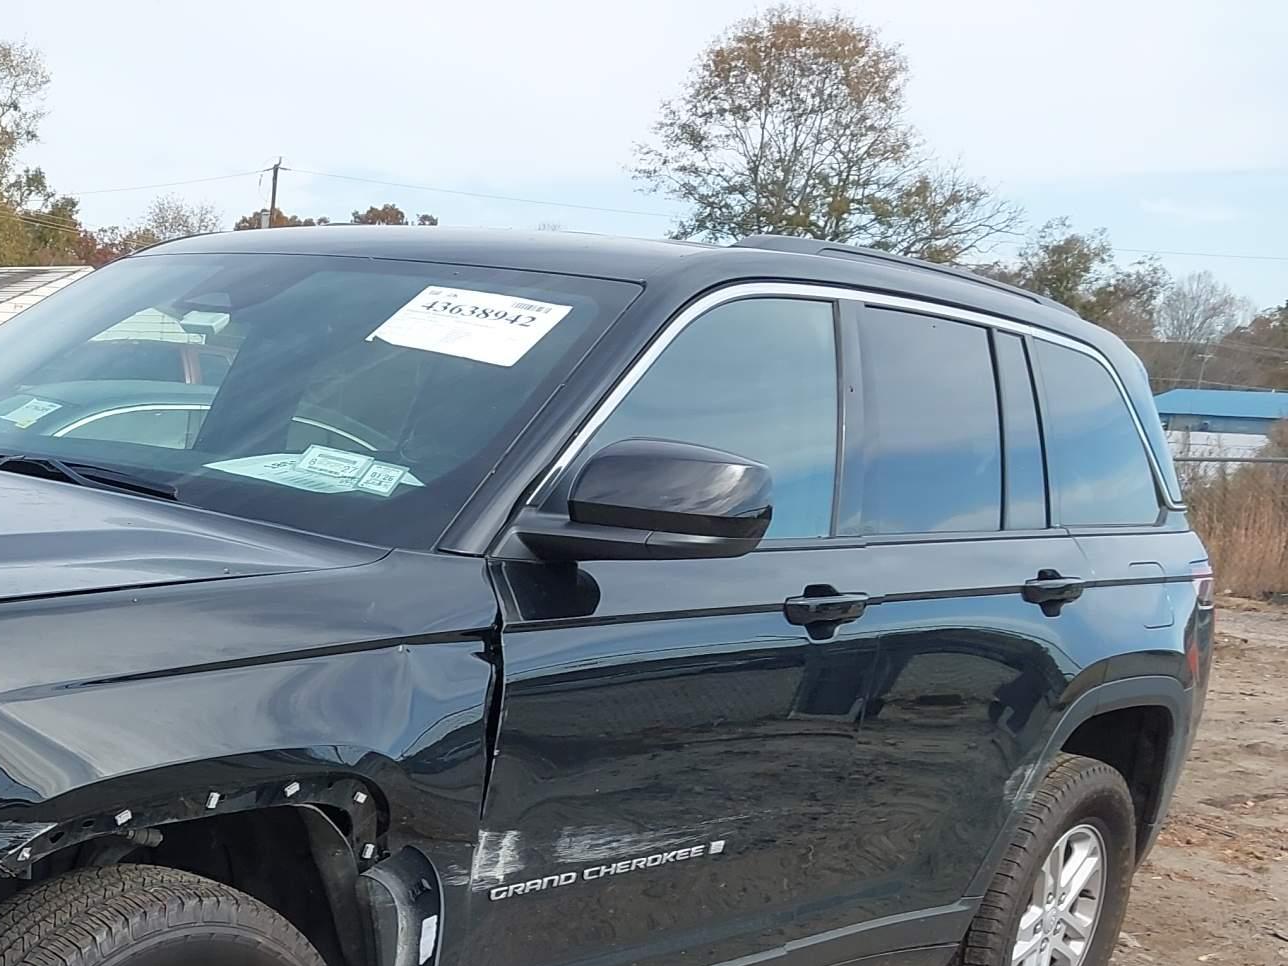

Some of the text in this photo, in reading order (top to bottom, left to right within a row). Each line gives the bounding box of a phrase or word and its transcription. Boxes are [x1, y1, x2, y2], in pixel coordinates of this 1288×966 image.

[421, 300, 537, 328] 43638942
[489, 844, 707, 902] GRAND CHEROKEE
